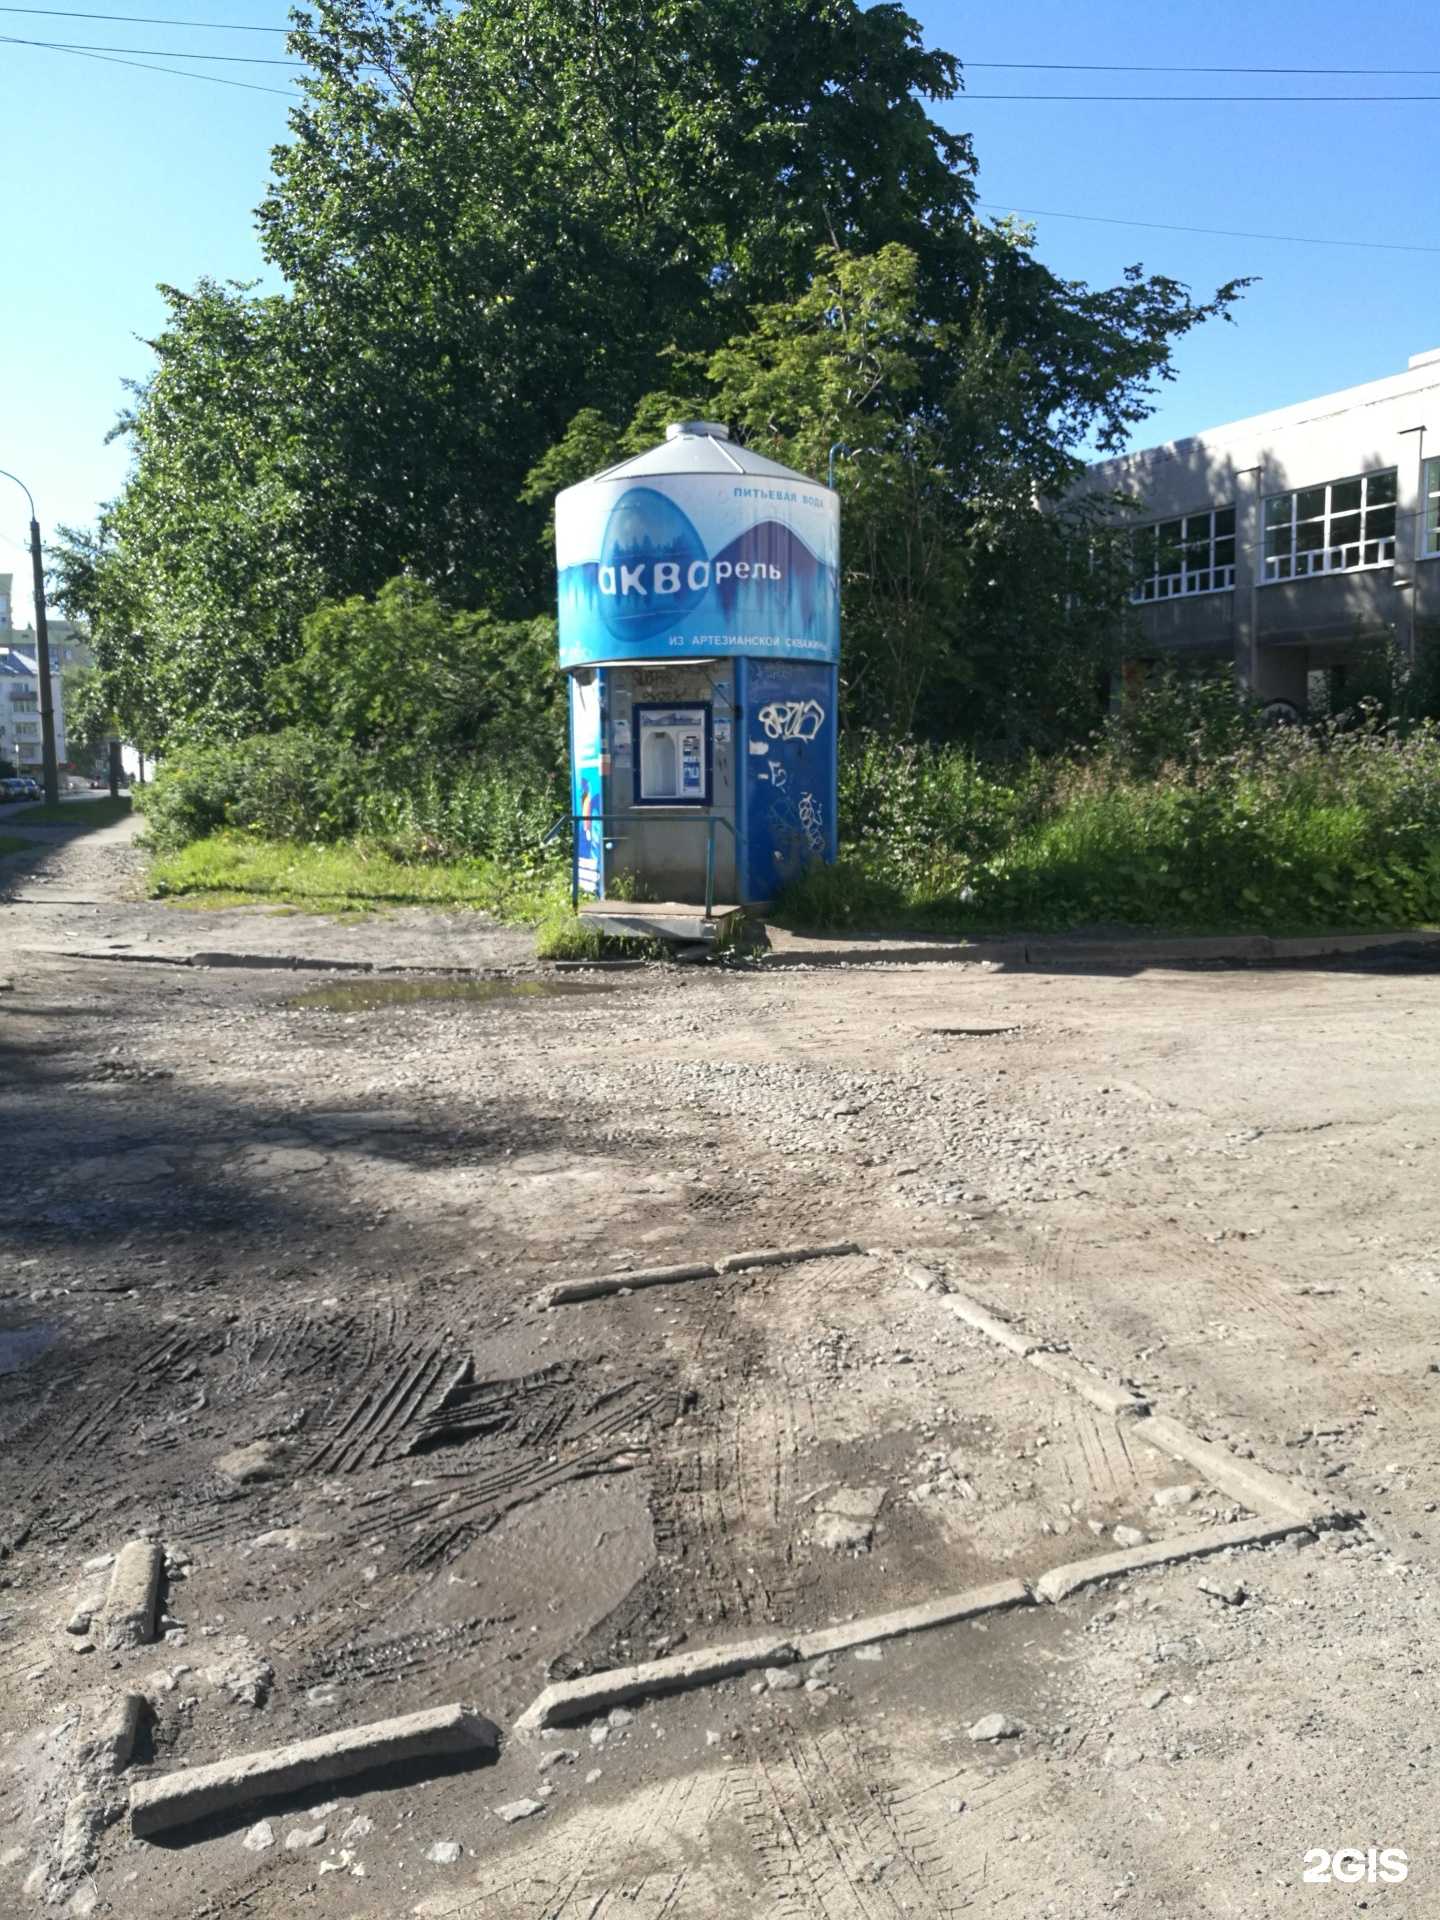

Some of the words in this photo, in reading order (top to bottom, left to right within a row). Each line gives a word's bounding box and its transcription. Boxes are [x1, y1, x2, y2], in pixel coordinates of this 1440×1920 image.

[733, 487, 798, 502] ПИТЬЕВАЯ
[669, 636, 684, 646] ИЗ
[692, 636, 780, 647] АРТЕЗИАНСКОЙ
